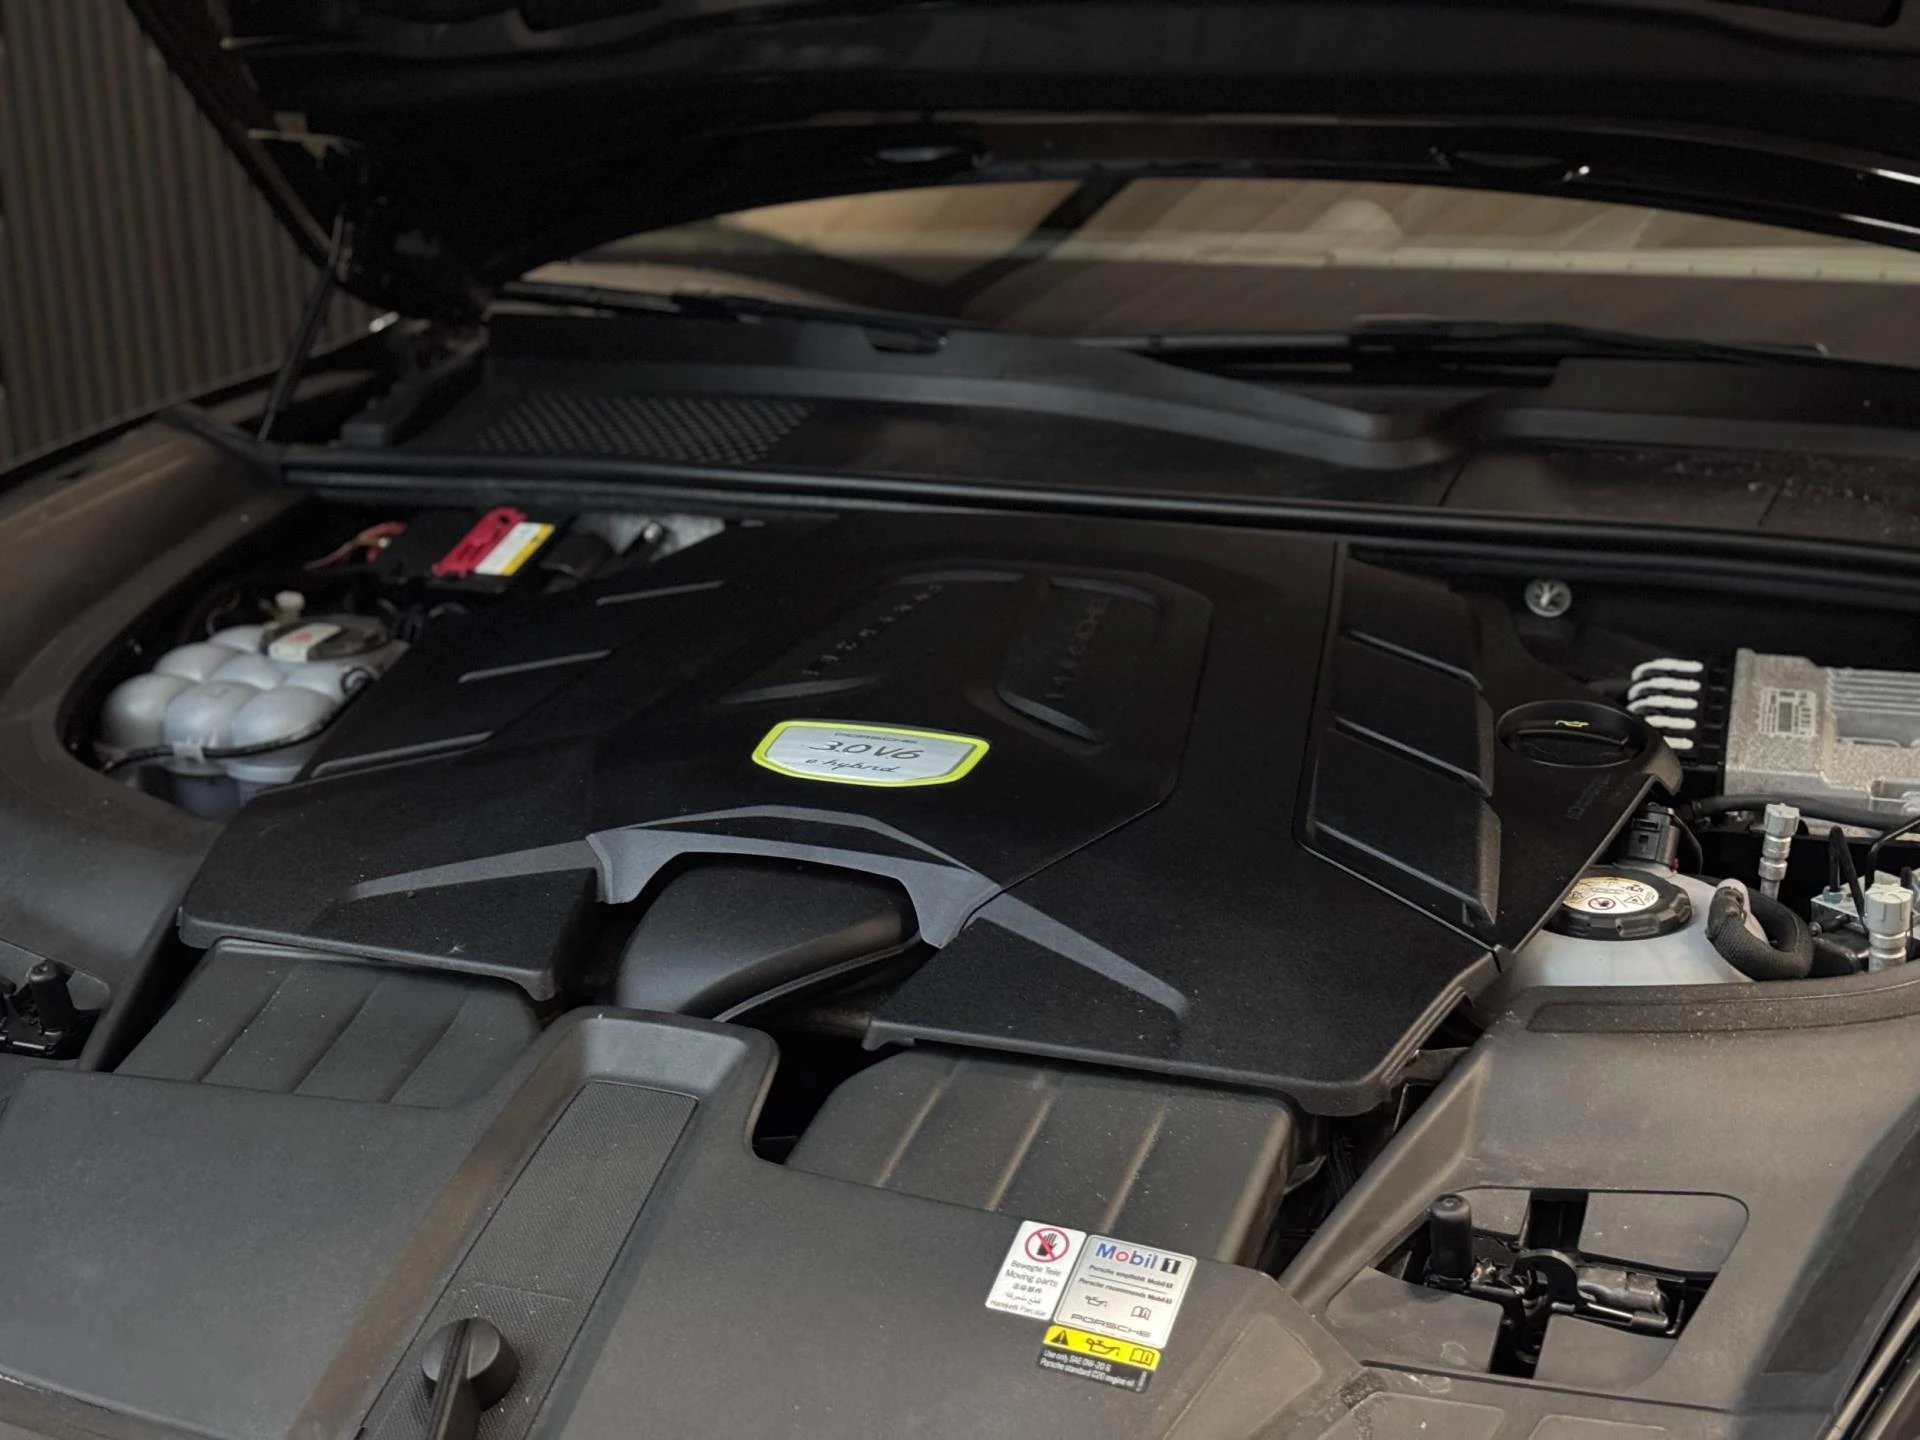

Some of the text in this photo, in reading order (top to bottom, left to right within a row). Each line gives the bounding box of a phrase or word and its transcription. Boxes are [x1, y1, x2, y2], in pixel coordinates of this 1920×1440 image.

[835, 731, 918, 744] PORSCHE
[1096, 1242, 1159, 1269] Mobil
[1006, 1269, 1059, 1289] Moving parts
[1010, 1259, 1062, 1276] Bewegte Teile
[1088, 1264, 1114, 1276] Porsche
[1116, 1269, 1145, 1282] empfiehlt
[1147, 1277, 1166, 1287] Mobil
[1079, 1277, 1104, 1289] Porsche
[1106, 1283, 1146, 1298] recommends
[1147, 1293, 1165, 1303] Mobil
[1070, 1313, 1152, 1338] PORSCHE
[1043, 1349, 1056, 1358] Use
[1056, 1352, 1068, 1363] only
[1070, 1355, 1083, 1365] SAE
[1039, 1357, 1065, 1370] Porsche
[1065, 1364, 1092, 1377] standard
[1105, 1374, 1126, 1385] engine
